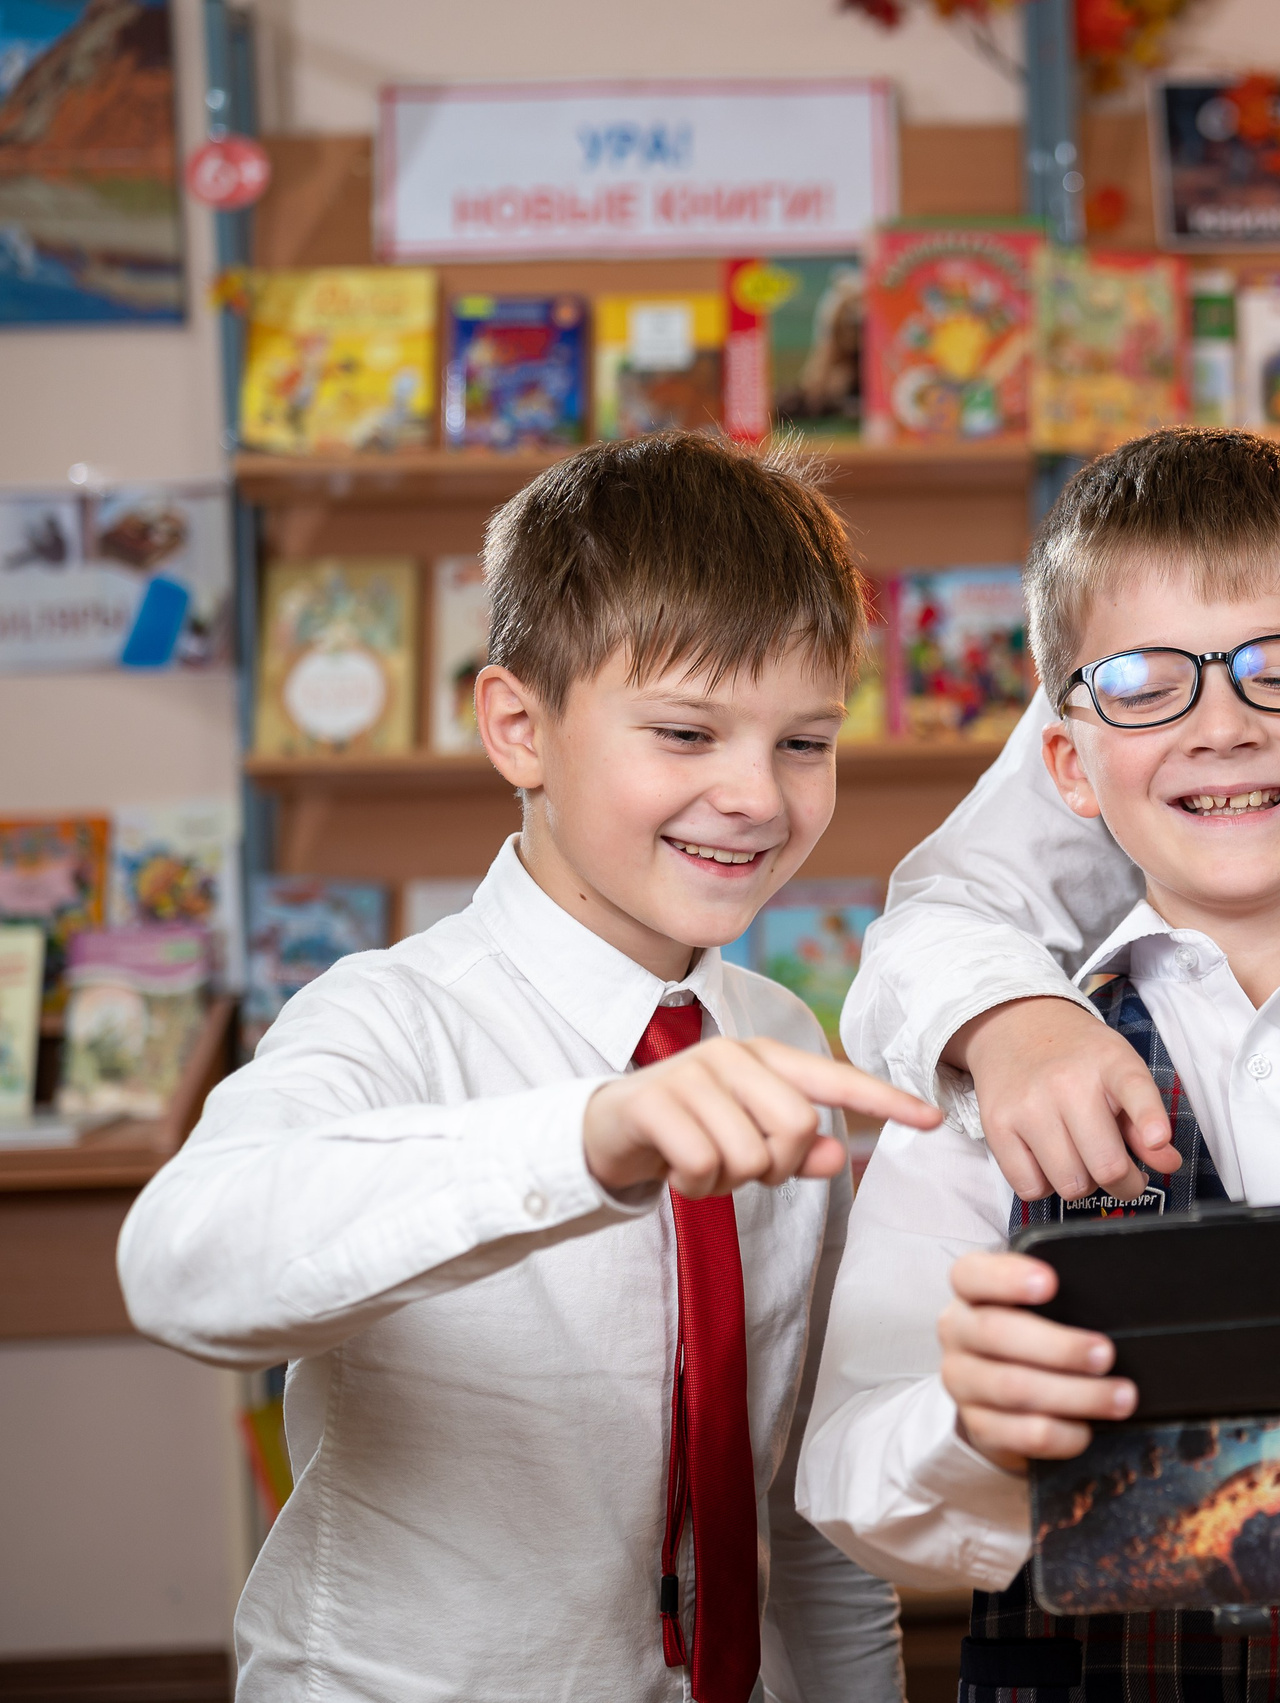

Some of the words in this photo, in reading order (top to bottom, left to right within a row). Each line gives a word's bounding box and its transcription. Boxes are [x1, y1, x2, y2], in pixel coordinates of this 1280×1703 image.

[580, 122, 691, 168] УРА!
[454, 183, 638, 231] НОВЫЕ
[655, 180, 833, 226] КНИГИ!
